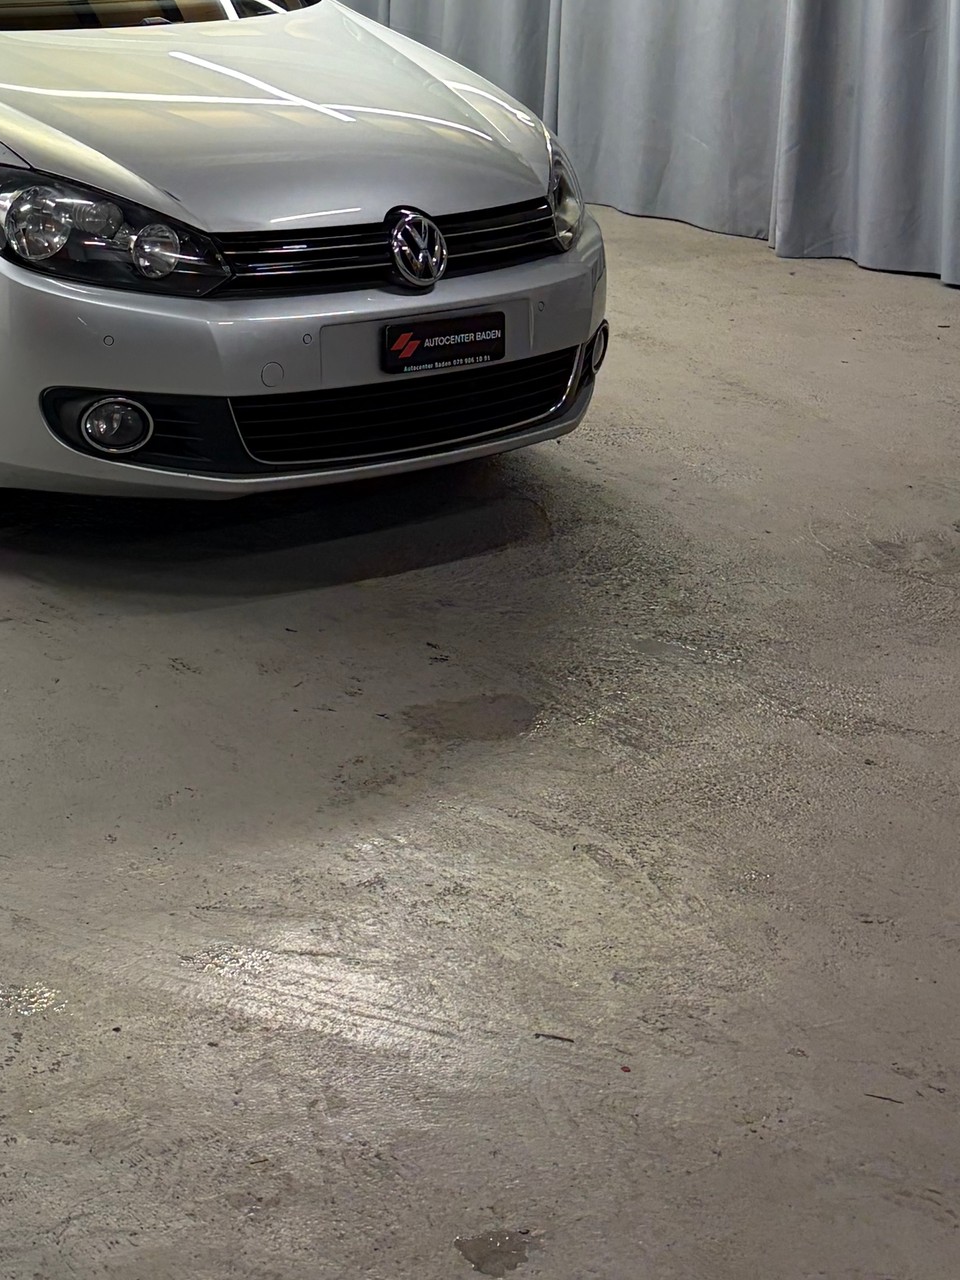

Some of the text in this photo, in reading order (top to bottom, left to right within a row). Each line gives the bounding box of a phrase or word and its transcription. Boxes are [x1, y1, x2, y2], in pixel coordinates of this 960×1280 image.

[424, 330, 502, 348] AUTOCENTER BADEN
[403, 361, 434, 372] Autocenter
[435, 360, 452, 369] Baden
